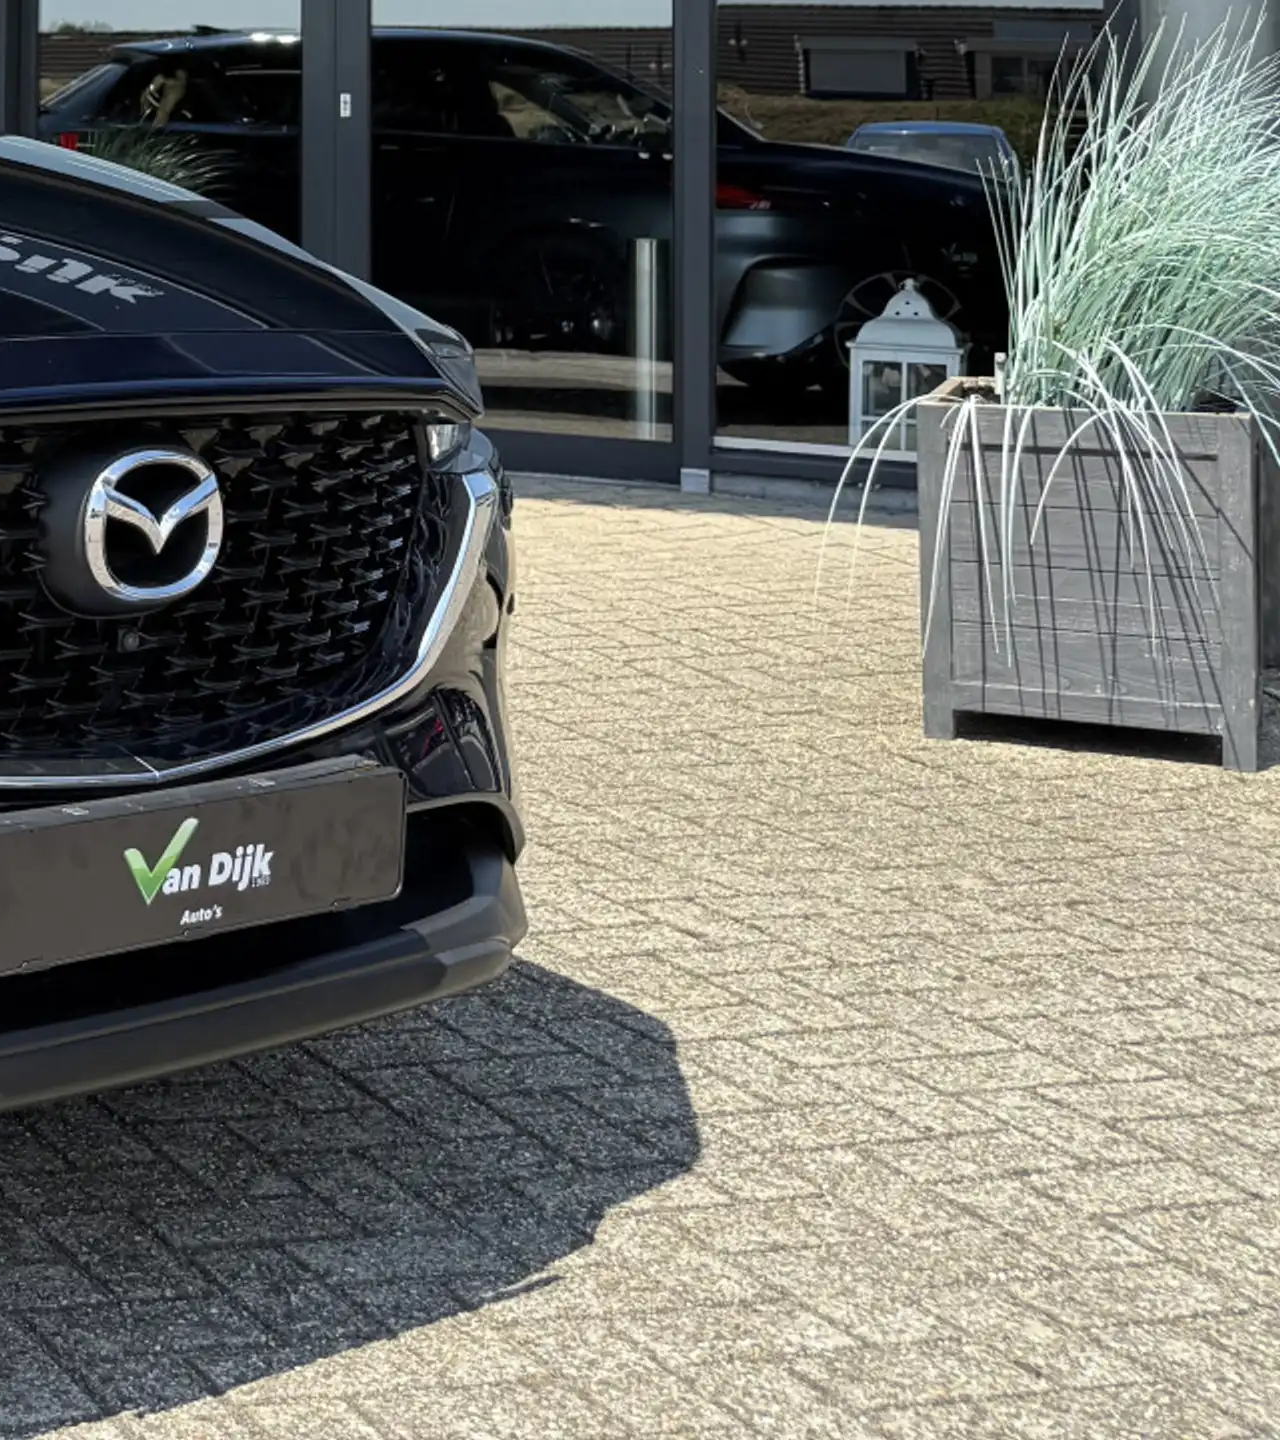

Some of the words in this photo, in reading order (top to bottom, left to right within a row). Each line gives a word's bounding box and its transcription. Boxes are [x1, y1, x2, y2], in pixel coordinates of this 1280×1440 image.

[123, 816, 202, 906] Van
[208, 843, 276, 892] Dijk
[180, 903, 224, 926] Auto's
